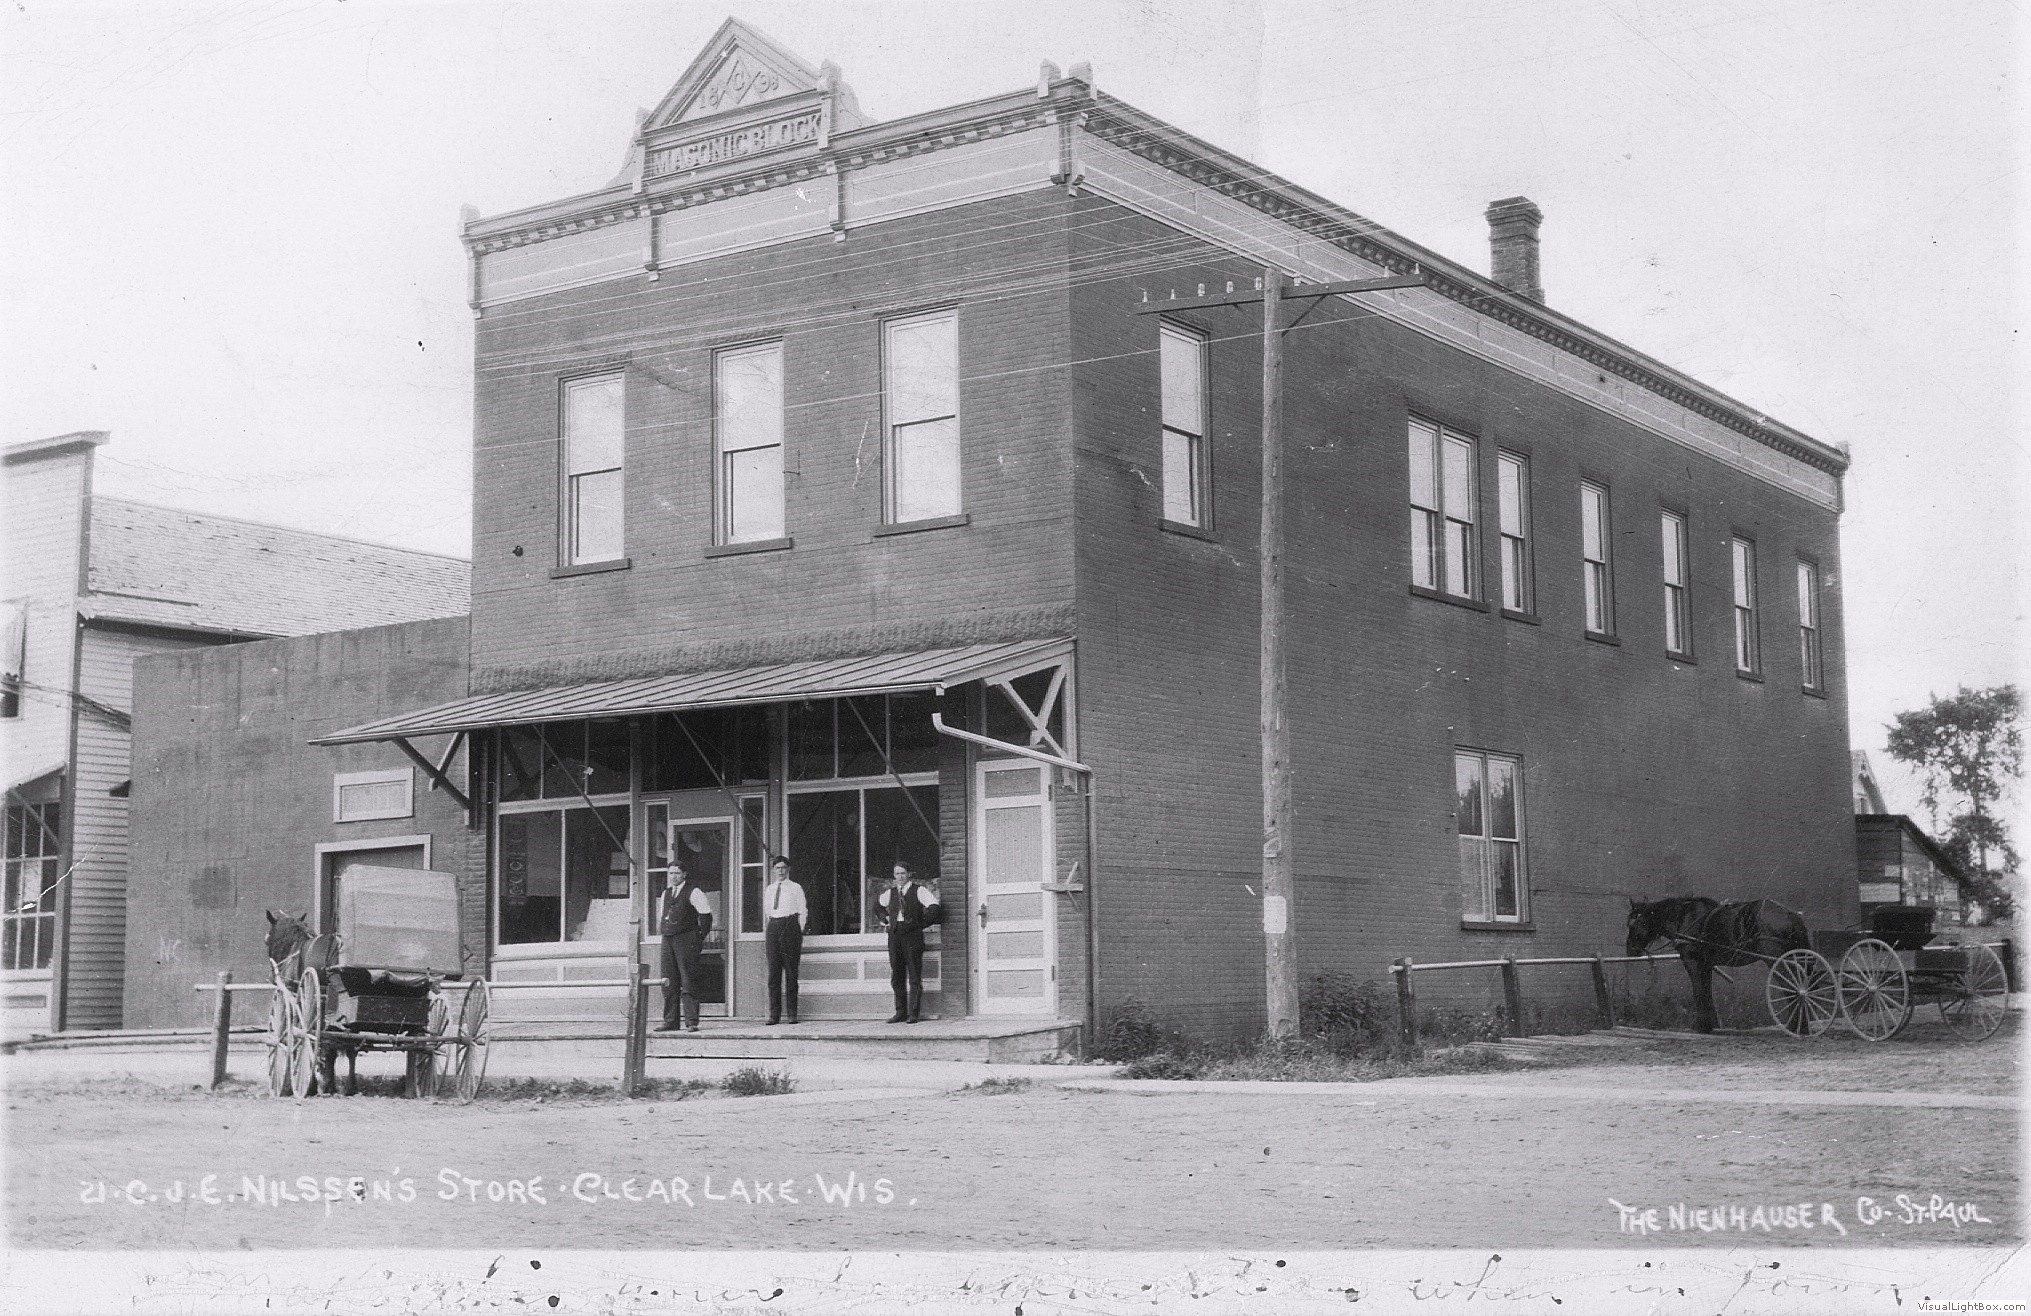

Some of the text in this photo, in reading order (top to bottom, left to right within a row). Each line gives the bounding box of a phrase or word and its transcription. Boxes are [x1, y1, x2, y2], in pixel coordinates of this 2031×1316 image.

[757, 73, 780, 94] 98
[652, 114, 823, 175] MASONIC BLOCK
